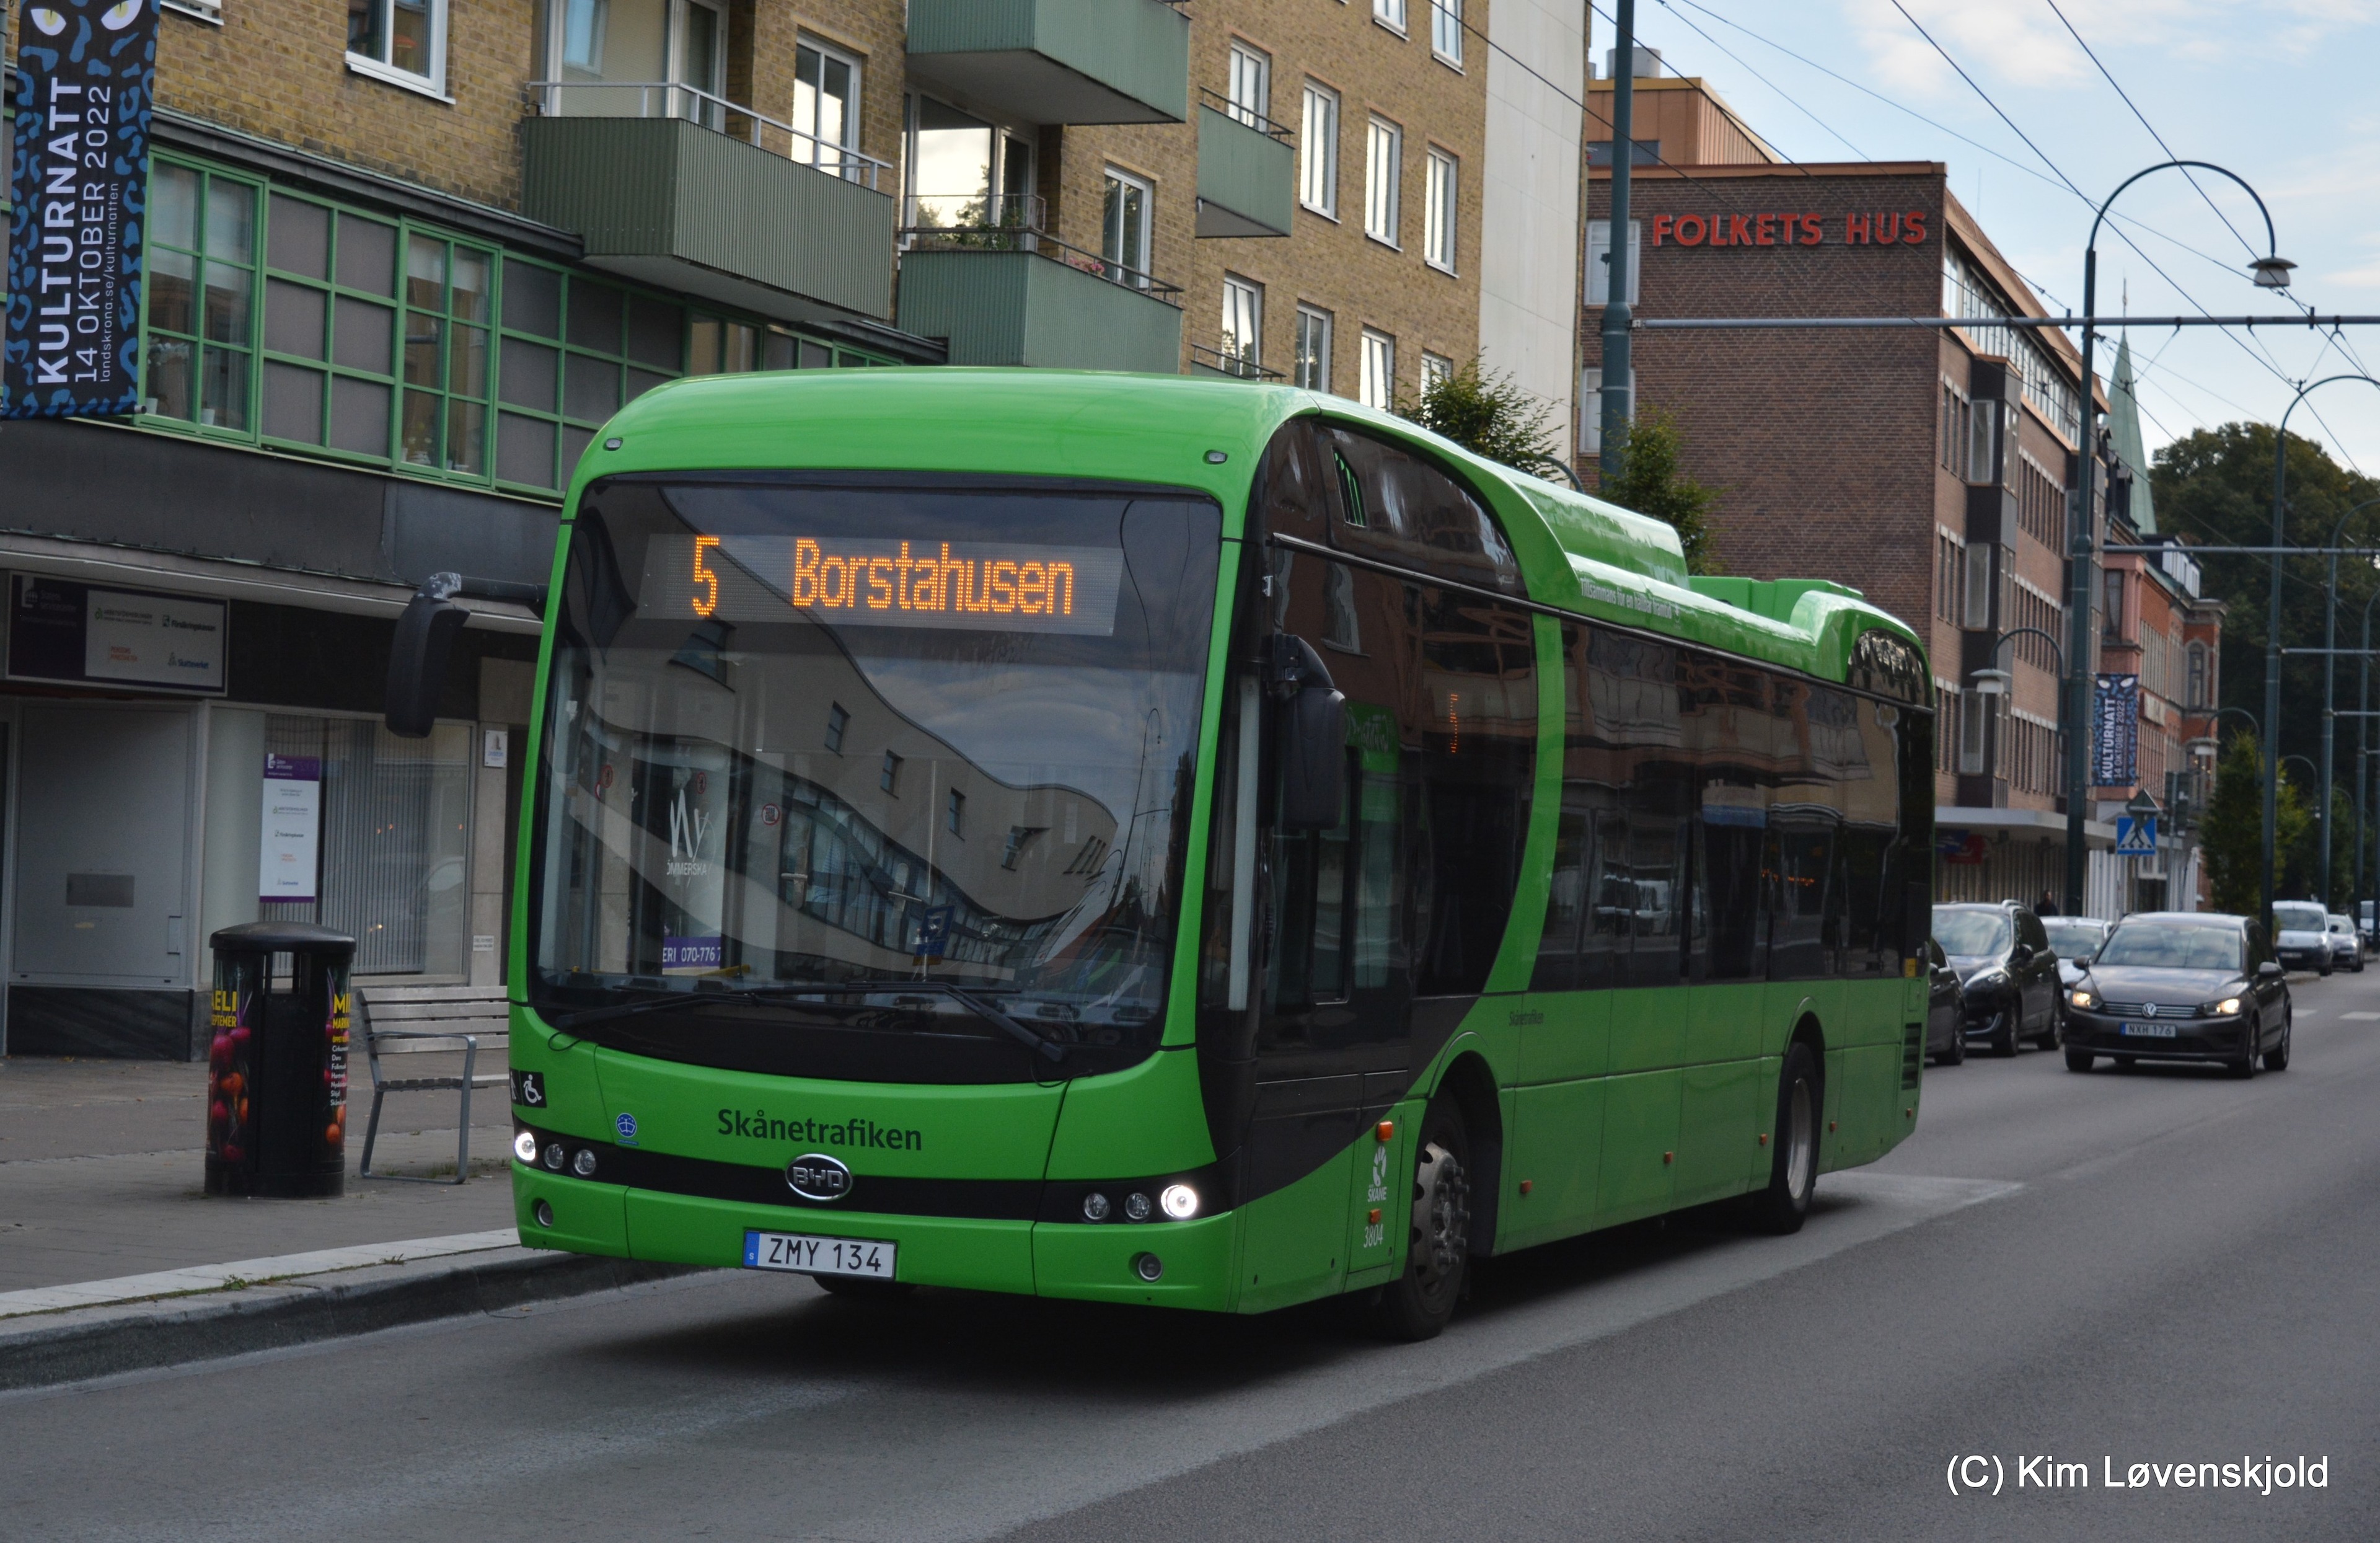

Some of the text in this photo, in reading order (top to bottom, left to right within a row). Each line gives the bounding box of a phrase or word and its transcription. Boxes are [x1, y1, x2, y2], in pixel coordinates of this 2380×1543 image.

[38, 77, 82, 384] KULTURNATT
[75, 86, 112, 383] 14 OKTOBER 2022
[1653, 211, 1926, 247] FOLKETS HUS
[100, 182, 119, 382] landskrona.se/kulturnatten
[692, 536, 1073, 617] 5 Borstahusen
[2115, 700, 2125, 723] 2022
[2102, 698, 2116, 779] KULTURNATT
[2114, 725, 2123, 766] OKTOBER
[681, 947, 715, 962] 070-776
[212, 990, 237, 1012] ELI
[718, 1108, 922, 1151] Skånetrafiken
[793, 1166, 844, 1189] BYD
[769, 1237, 881, 1272] ZMY 134
[1364, 1224, 1383, 1248] 3804
